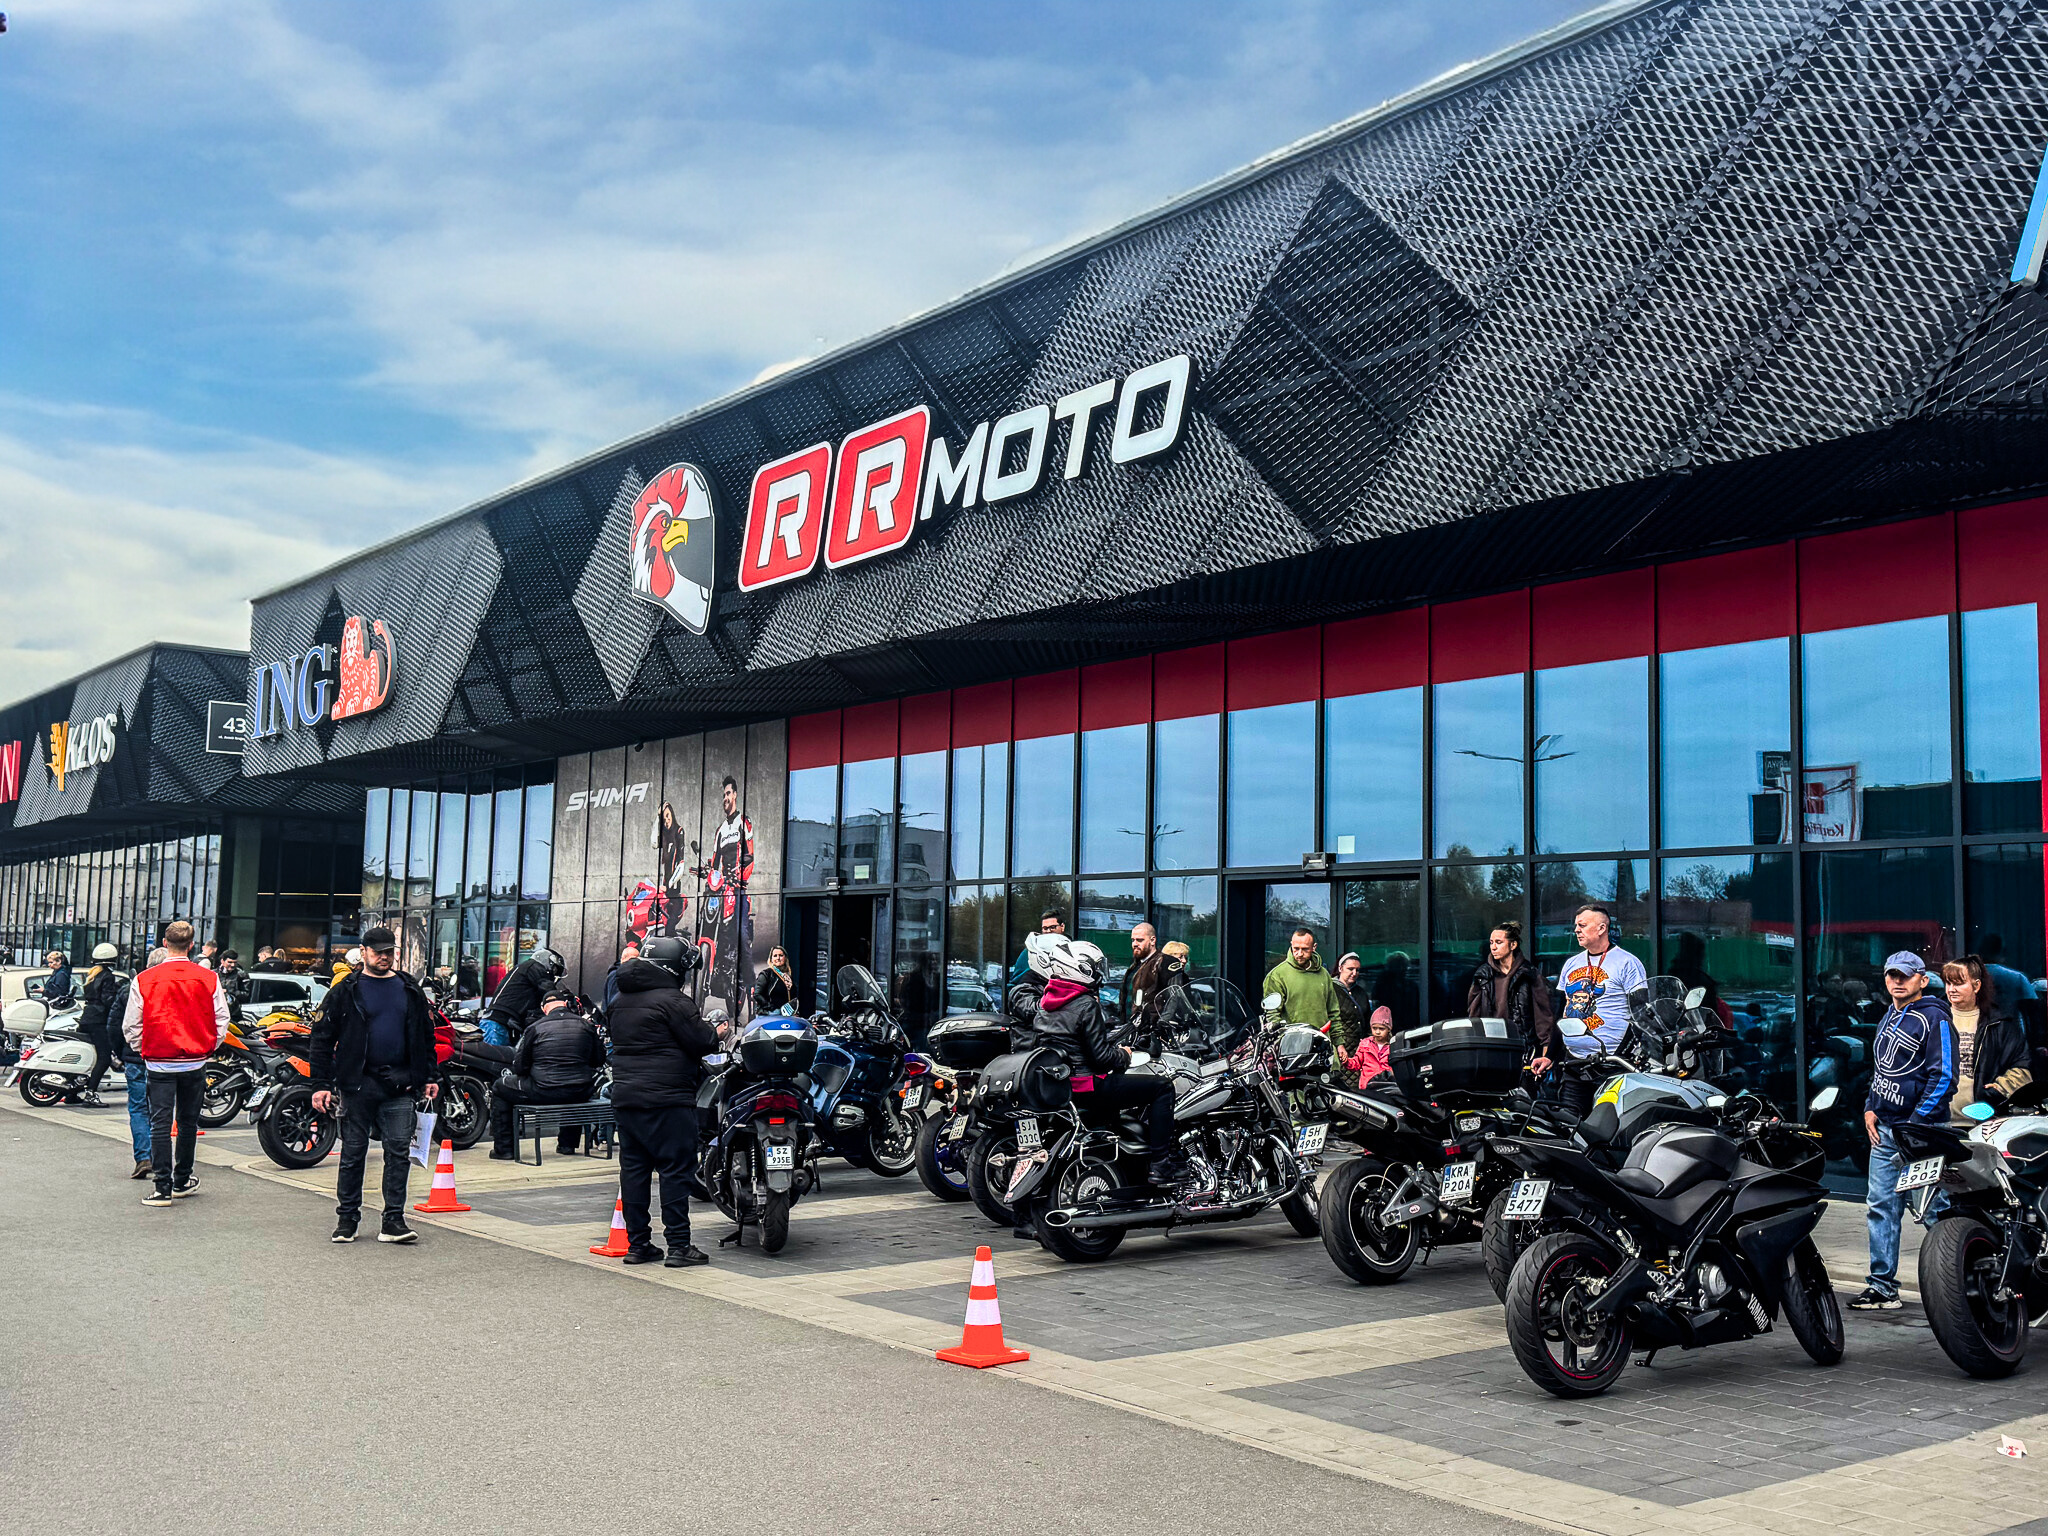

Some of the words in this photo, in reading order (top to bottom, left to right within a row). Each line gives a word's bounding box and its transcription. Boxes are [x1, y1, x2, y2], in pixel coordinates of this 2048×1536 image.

[920, 354, 1191, 521] MOTO
[251, 643, 333, 739] ING
[223, 717, 247, 733] 43
[64, 713, 118, 773] KŁOS
[0, 740, 21, 803] N
[565, 782, 649, 812] SHIMA
[1874, 1070, 1900, 1094] ERGIO
[1307, 1126, 1321, 1137] SH
[776, 1147, 788, 1155] SZ
[1299, 1138, 1323, 1149] 4989
[1450, 1165, 1469, 1179] KRA
[1899, 1169, 1938, 1186] 5902
[1507, 1199, 1541, 1212] 5477
[1747, 1293, 1769, 1332] YAMAHA
